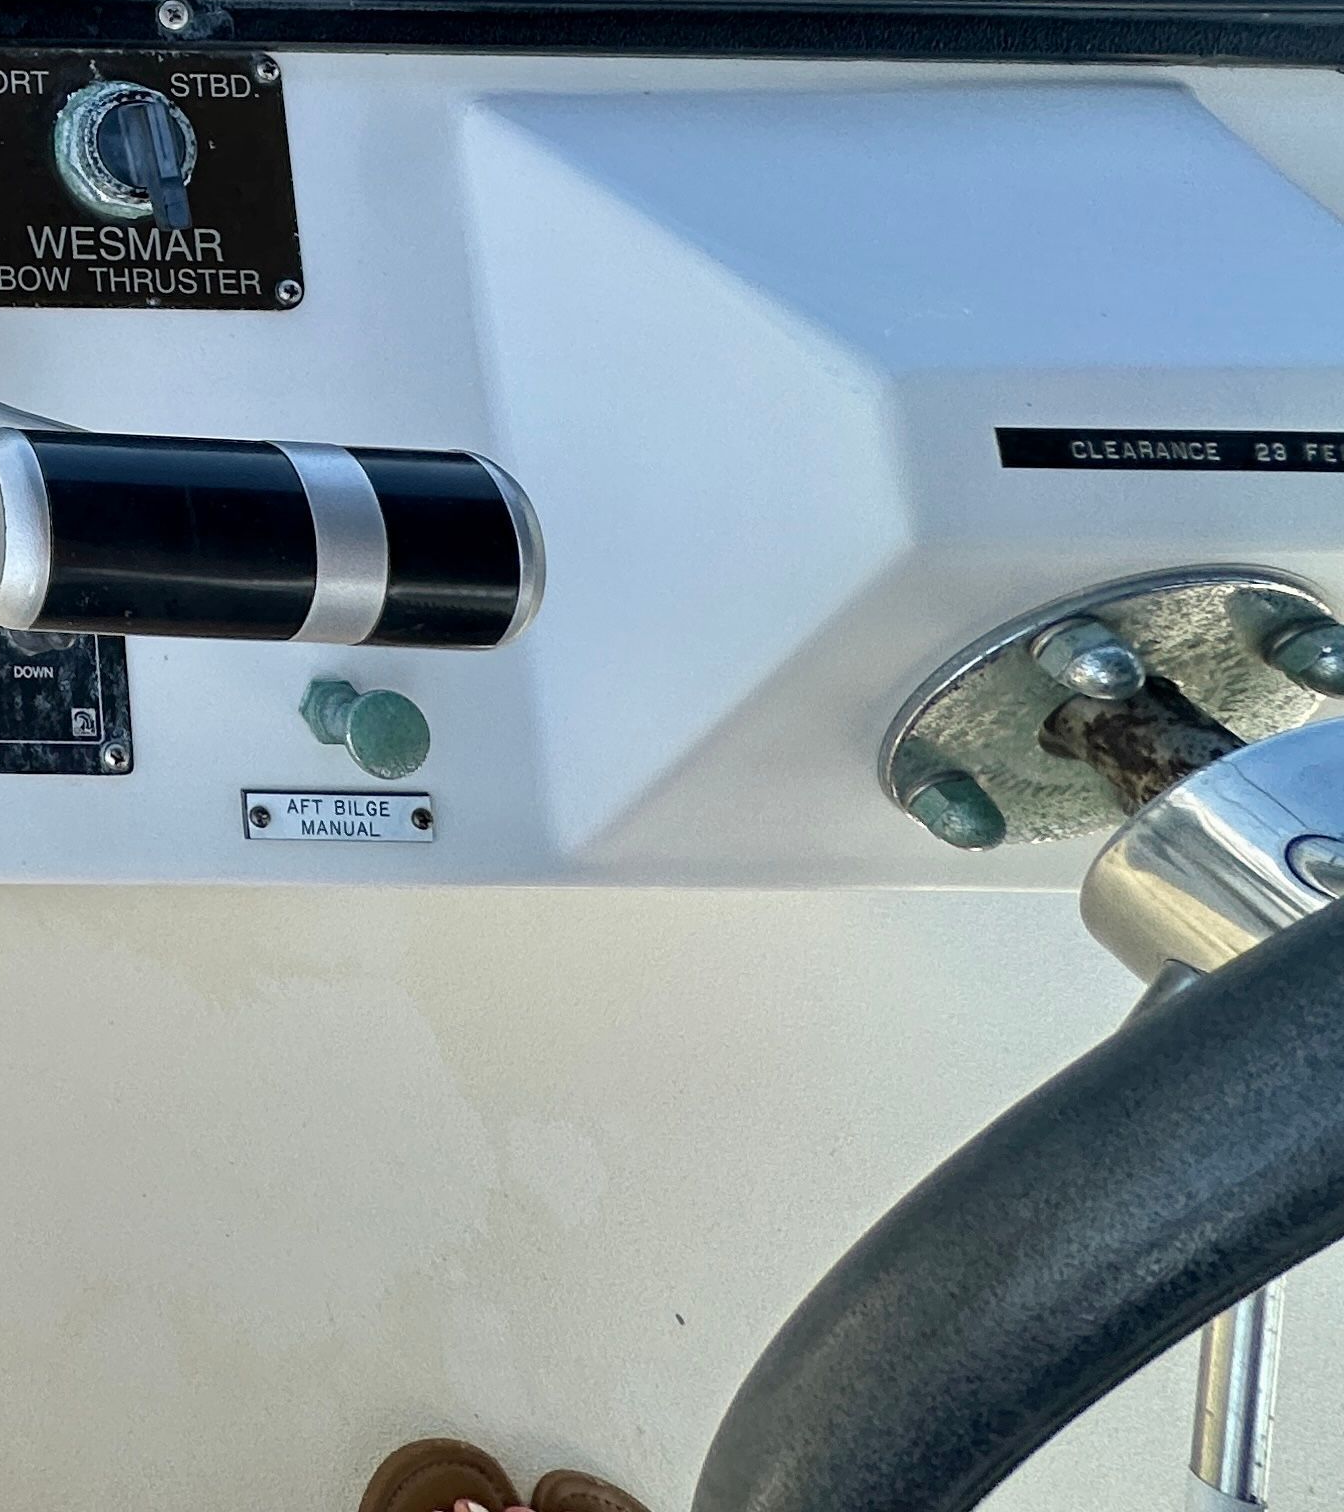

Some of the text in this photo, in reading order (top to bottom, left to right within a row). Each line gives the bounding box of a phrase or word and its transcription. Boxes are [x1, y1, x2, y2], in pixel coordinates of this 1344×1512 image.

[169, 72, 260, 99] STBD.
[26, 225, 224, 262] WESMAR
[88, 266, 262, 295] THRUSTER
[1070, 440, 1221, 461] CLEARANCE
[14, 665, 54, 678] DOWN
[287, 798, 390, 817] AFT BILGE
[301, 820, 381, 837] MANUAL
